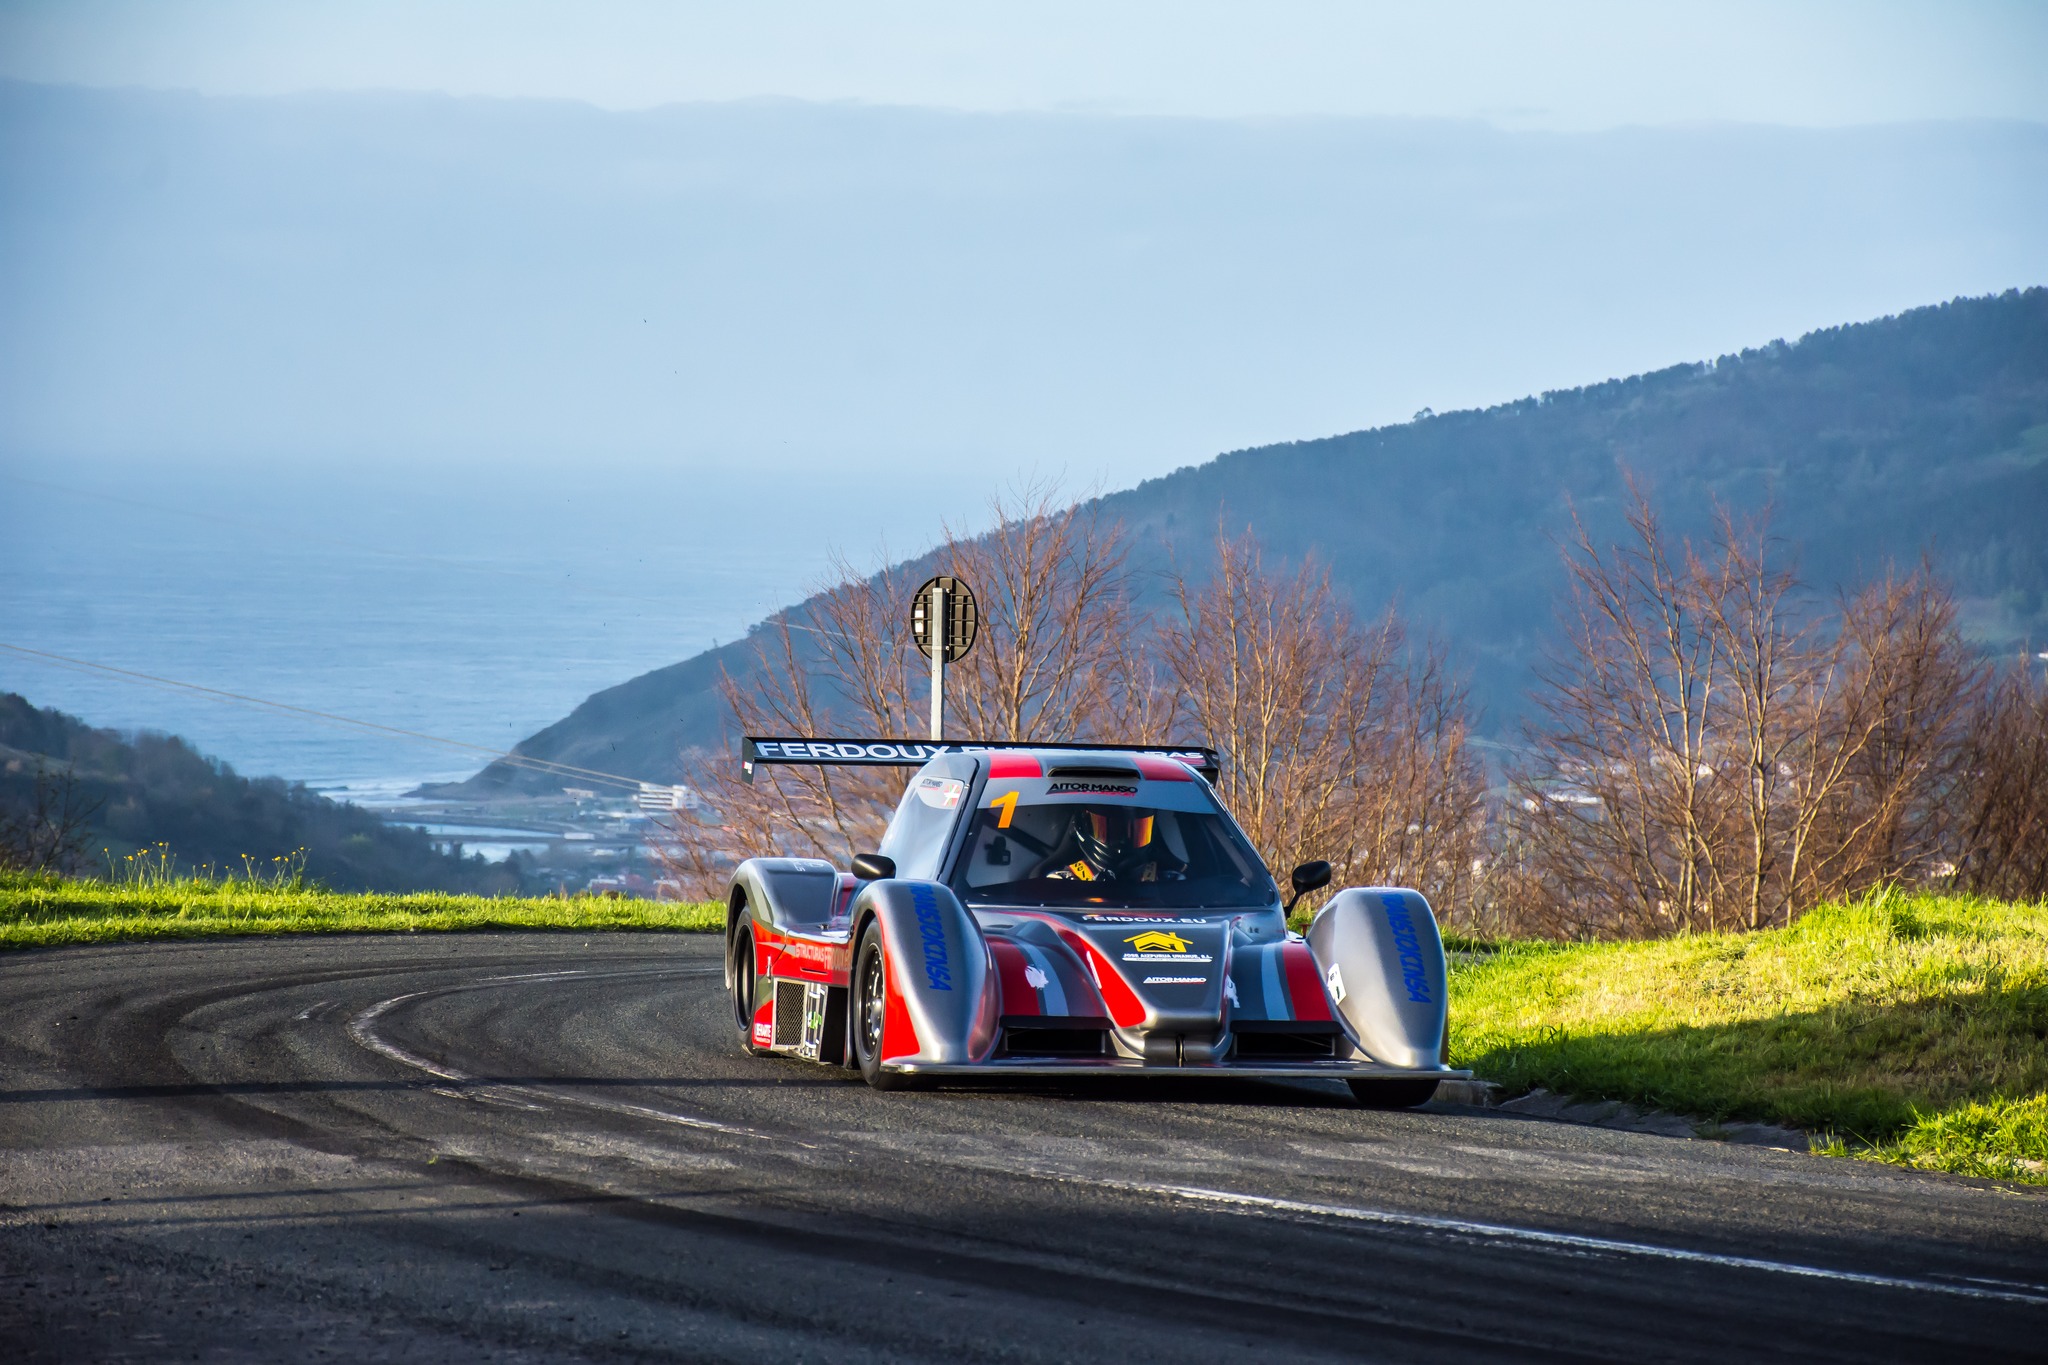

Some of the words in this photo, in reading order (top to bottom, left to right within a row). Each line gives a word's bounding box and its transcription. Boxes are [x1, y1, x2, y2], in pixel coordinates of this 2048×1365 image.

[755, 742, 950, 759] FERDOUX
[1048, 782, 1090, 792] AITOR
[1091, 783, 1138, 794] MANSO
[990, 790, 1020, 829] 1
[1082, 915, 1207, 924] FERDOUX.EU
